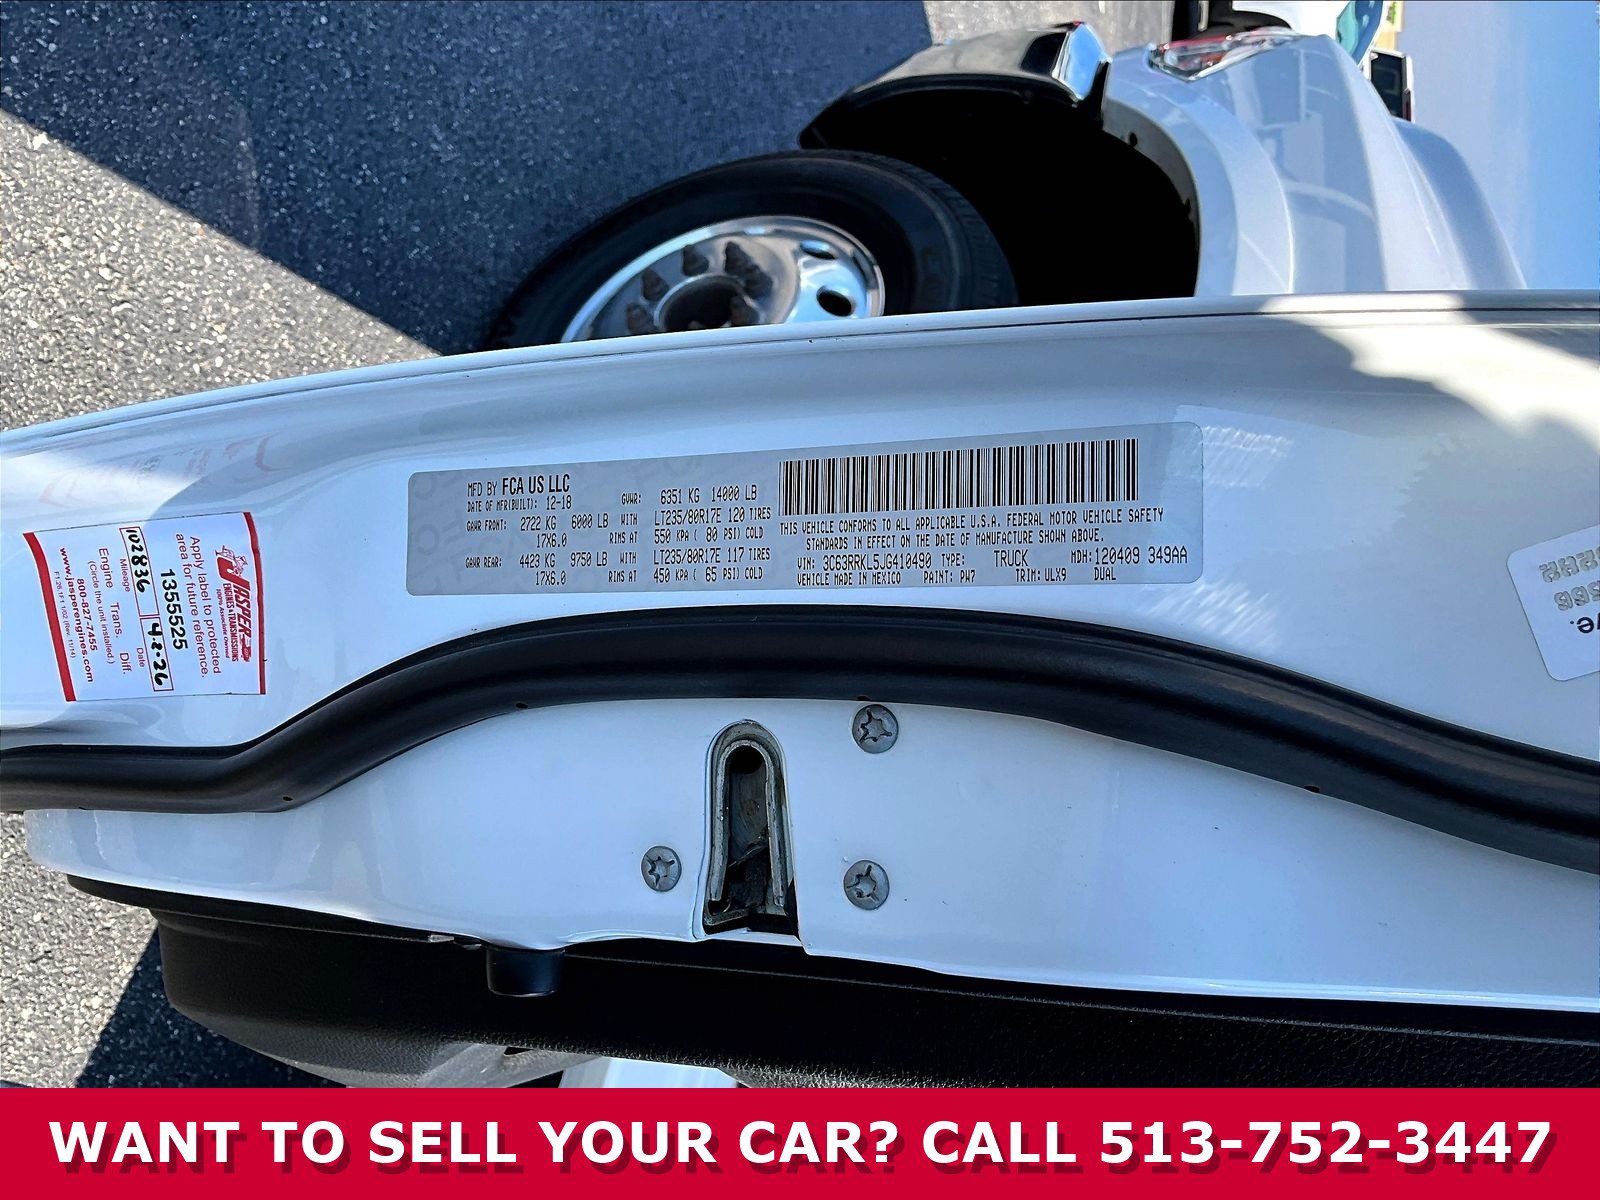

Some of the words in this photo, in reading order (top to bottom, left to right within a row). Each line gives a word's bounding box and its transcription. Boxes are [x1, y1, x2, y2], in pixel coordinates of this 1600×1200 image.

[468, 482, 482, 496] MFD
[487, 482, 497, 495] BY
[502, 477, 524, 495] FCA
[528, 475, 544, 494] US
[548, 474, 570, 492] LLC
[622, 493, 641, 505] GVWR:
[661, 489, 682, 504] 6351
[688, 488, 700, 503] KG
[712, 486, 739, 502] 14000
[746, 485, 757, 500] LB
[467, 501, 482, 512] DATE
[486, 500, 494, 511] OF
[546, 495, 572, 510] 12-18
[467, 520, 482, 532] GAWR
[484, 519, 506, 531] FRONT:
[520, 516, 541, 531] 2722
[546, 516, 556, 530] KG
[571, 514, 592, 529] 6000
[598, 513, 608, 528] LB
[621, 513, 638, 526] WITH
[654, 508, 722, 526] LT235/80R17E
[728, 507, 744, 523] 120
[750, 507, 770, 520] TIRES
[780, 522, 798, 535] THIS
[802, 520, 834, 534] VEHICLE
[839, 519, 877, 533] CONFORMS
[882, 518, 892, 531] TO
[896, 518, 910, 531] ALL
[916, 515, 966, 530] APPLICABLE
[971, 514, 1000, 528] U.S.A.
[1008, 512, 1044, 526] FEDERAL
[1050, 511, 1077, 524] MOTOR
[1082, 509, 1122, 524] VEHICLE
[1128, 508, 1164, 522] SAFETY
[176, 534, 188, 560] area
[536, 533, 567, 548] 17X6.0
[610, 532, 626, 544] RIMS
[630, 532, 638, 543] AT
[654, 529, 671, 544] 550
[676, 530, 688, 542] KPA
[706, 527, 718, 542] 80
[724, 528, 740, 540] PSI)
[746, 526, 763, 539] COLD
[806, 536, 848, 550] STANDARDS
[854, 536, 862, 549] IN
[867, 535, 896, 549] EFFECT
[900, 534, 910, 548] ON
[916, 534, 930, 547] THE
[936, 533, 955, 546] DATE
[960, 533, 970, 546] OF
[976, 530, 1033, 546] MANUFACTURE
[1039, 530, 1066, 543] SHOWN
[1072, 528, 1104, 542] ABOVE.
[126, 529, 150, 593] 102836
[190, 536, 204, 570] Apply
[466, 557, 480, 568] GAWR
[484, 556, 502, 568] REAR:
[520, 554, 540, 568] 4423
[544, 553, 556, 568] KG
[570, 552, 592, 568] 9750
[596, 552, 608, 566] LB
[620, 552, 636, 564] WITH
[654, 547, 721, 564] LT235/80R17E
[728, 547, 744, 563] 117
[750, 548, 770, 560] TIRES
[798, 557, 815, 570] VIN:
[822, 554, 932, 572] 3C63RRKL5JG410490
[942, 553, 965, 567] TYPE:
[994, 549, 1028, 567] TRUCK
[1148, 546, 1188, 564] 349AA
[88, 560, 99, 588] (Circle
[120, 558, 130, 592] Mileage
[183, 564, 192, 579] for
[536, 570, 566, 586] 17X6.0
[608, 570, 625, 582] RIMS
[628, 570, 637, 582] AT
[654, 568, 670, 583] 450
[676, 568, 688, 580] KPA
[706, 567, 717, 582] 65
[722, 568, 740, 580] PSI)
[744, 567, 762, 580] COLD
[798, 572, 829, 586] VEHICLE
[834, 572, 852, 586] MADE
[858, 572, 867, 584] IN
[872, 571, 900, 584] MEXICO
[924, 570, 952, 584] PAINT:
[960, 570, 976, 583] PW7
[1016, 568, 1041, 582] TRIM:
[1044, 568, 1066, 582] ULX9
[1094, 567, 1116, 580] DUAL
[94, 590, 102, 604] the
[186, 583, 199, 616] future
[198, 573, 211, 600] label
[217, 556, 252, 638] JASPER
[223, 583, 234, 608] ENGINES
[60, 547, 94, 682] www.jasperengines.com
[76, 578, 98, 651] 800-827-7455
[98, 606, 106, 623] unit
[99, 548, 114, 588] Engine
[110, 602, 122, 638] Trans.
[120, 652, 132, 674] Diff.
[160, 568, 188, 650] 1355525
[204, 604, 212, 616] to
[220, 606, 228, 636] Associate
[101, 624, 115, 664] installed.)
[192, 620, 208, 678] reference.
[204, 620, 221, 674] protected
[228, 612, 238, 662] TRANSMISSIONS
[136, 648, 144, 668] Date
